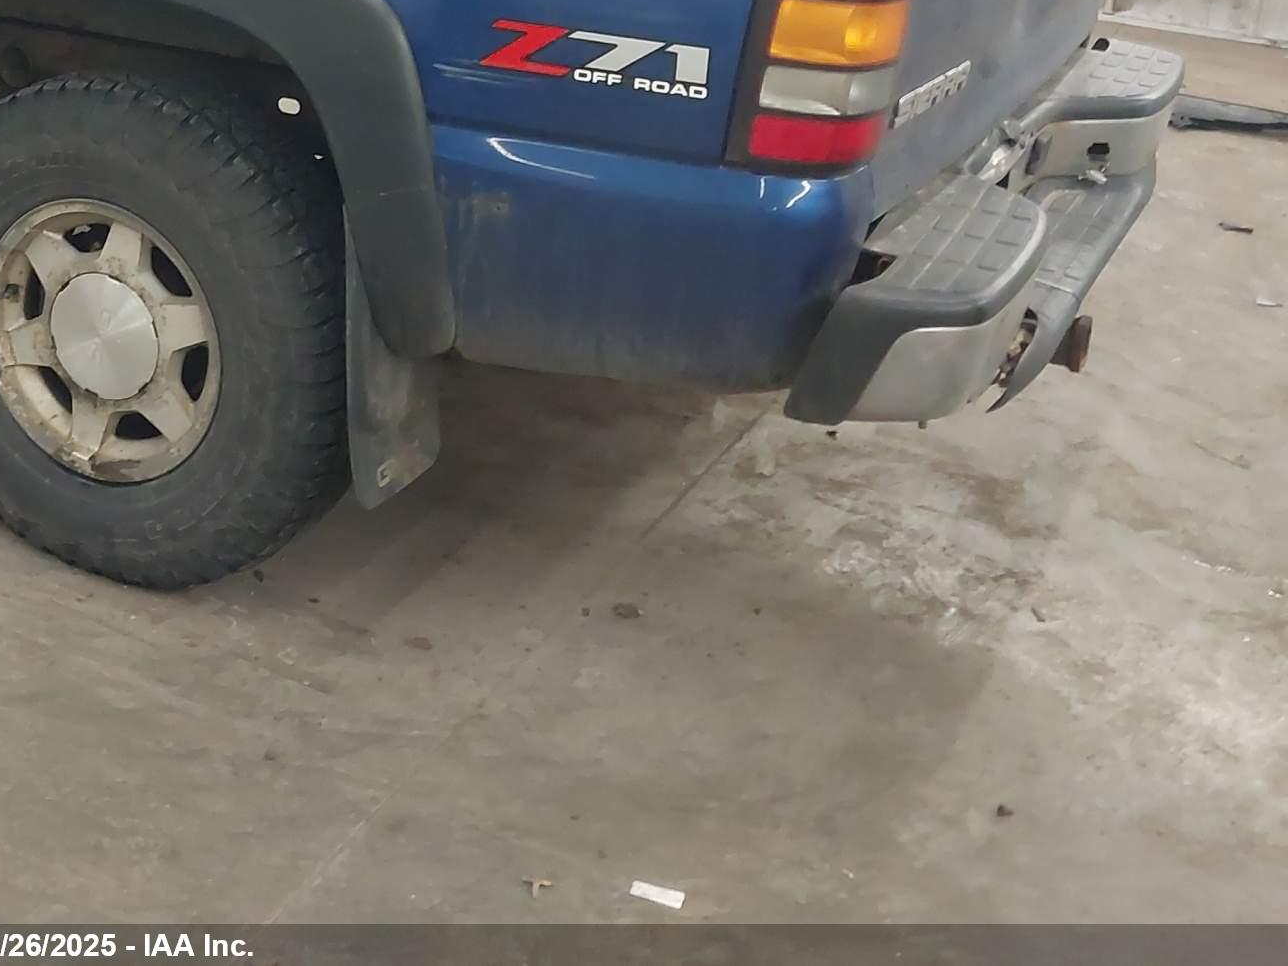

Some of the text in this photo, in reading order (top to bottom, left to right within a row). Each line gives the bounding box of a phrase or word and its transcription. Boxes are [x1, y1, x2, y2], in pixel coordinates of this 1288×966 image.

[479, 19, 710, 85] Z71
[573, 68, 708, 100] OFF ROAD
